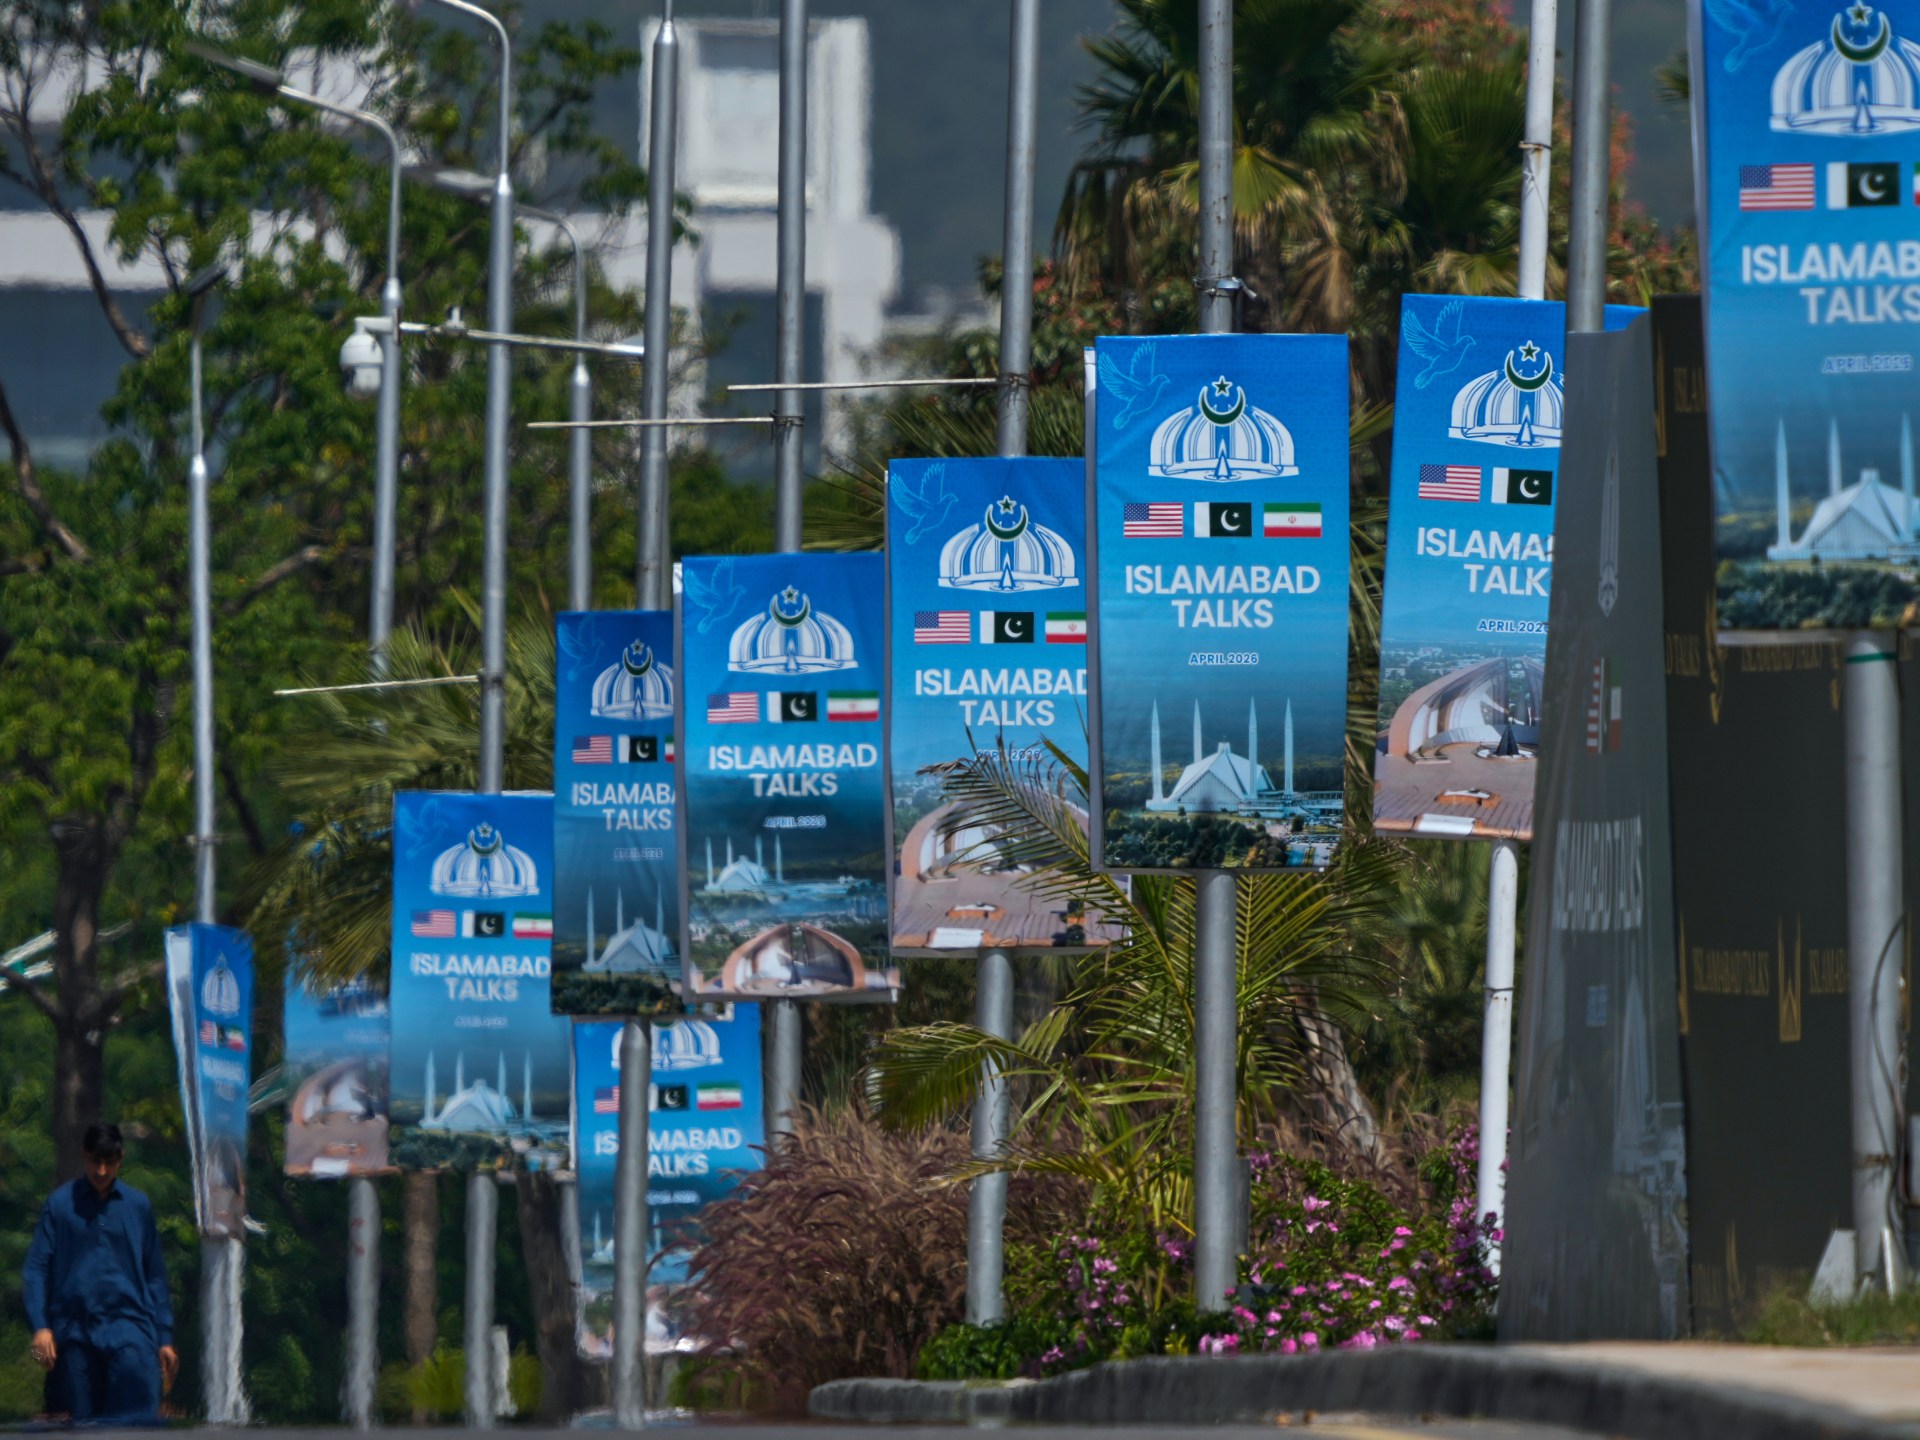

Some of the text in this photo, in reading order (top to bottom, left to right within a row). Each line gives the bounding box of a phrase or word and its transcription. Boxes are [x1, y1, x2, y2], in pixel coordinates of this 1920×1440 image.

[1125, 565, 1321, 594] ISLAMABAD
[1171, 598, 1274, 628] TALKS
[1477, 619, 1515, 633] APRIL
[1188, 652, 1259, 665] APRIL 2026
[958, 699, 1055, 726] TALKS
[709, 743, 878, 770] ISLAMABAD
[571, 782, 676, 806] ISLAMAB
[748, 772, 839, 797] TALKS
[602, 807, 673, 831] TALKS
[410, 952, 551, 977] ISLAMABAD
[444, 977, 519, 1002] TALKS
[594, 1127, 743, 1155] ISMABAD
[647, 1152, 709, 1178] ALKS
